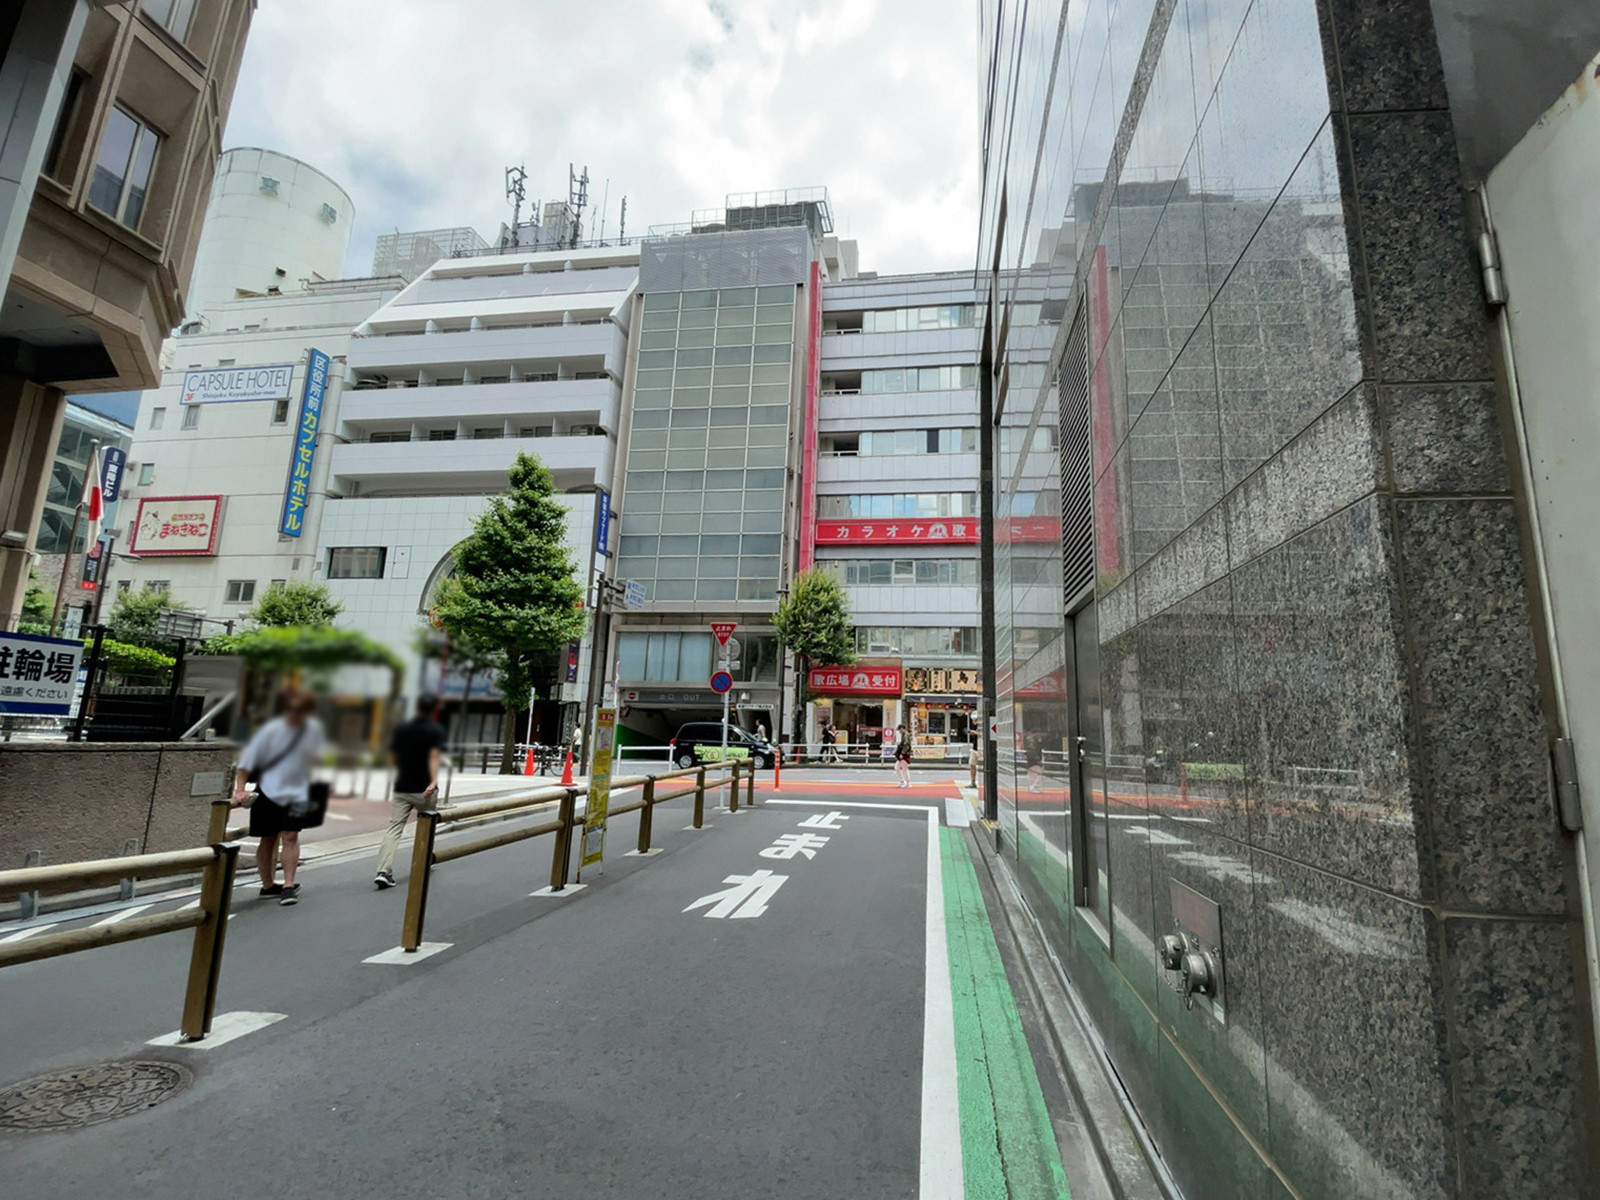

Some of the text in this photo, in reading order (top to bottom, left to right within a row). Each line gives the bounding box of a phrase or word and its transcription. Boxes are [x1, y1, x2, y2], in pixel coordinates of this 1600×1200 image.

[187, 369, 287, 392] CAPSULE HOTEL
[184, 393, 194, 401] 3F
[159, 522, 208, 539] まねきねこ
[837, 525, 924, 538] カラオケ
[872, 674, 896, 687] 受付
[683, 693, 700, 702] OUT
[681, 811, 850, 919] 止まれ
